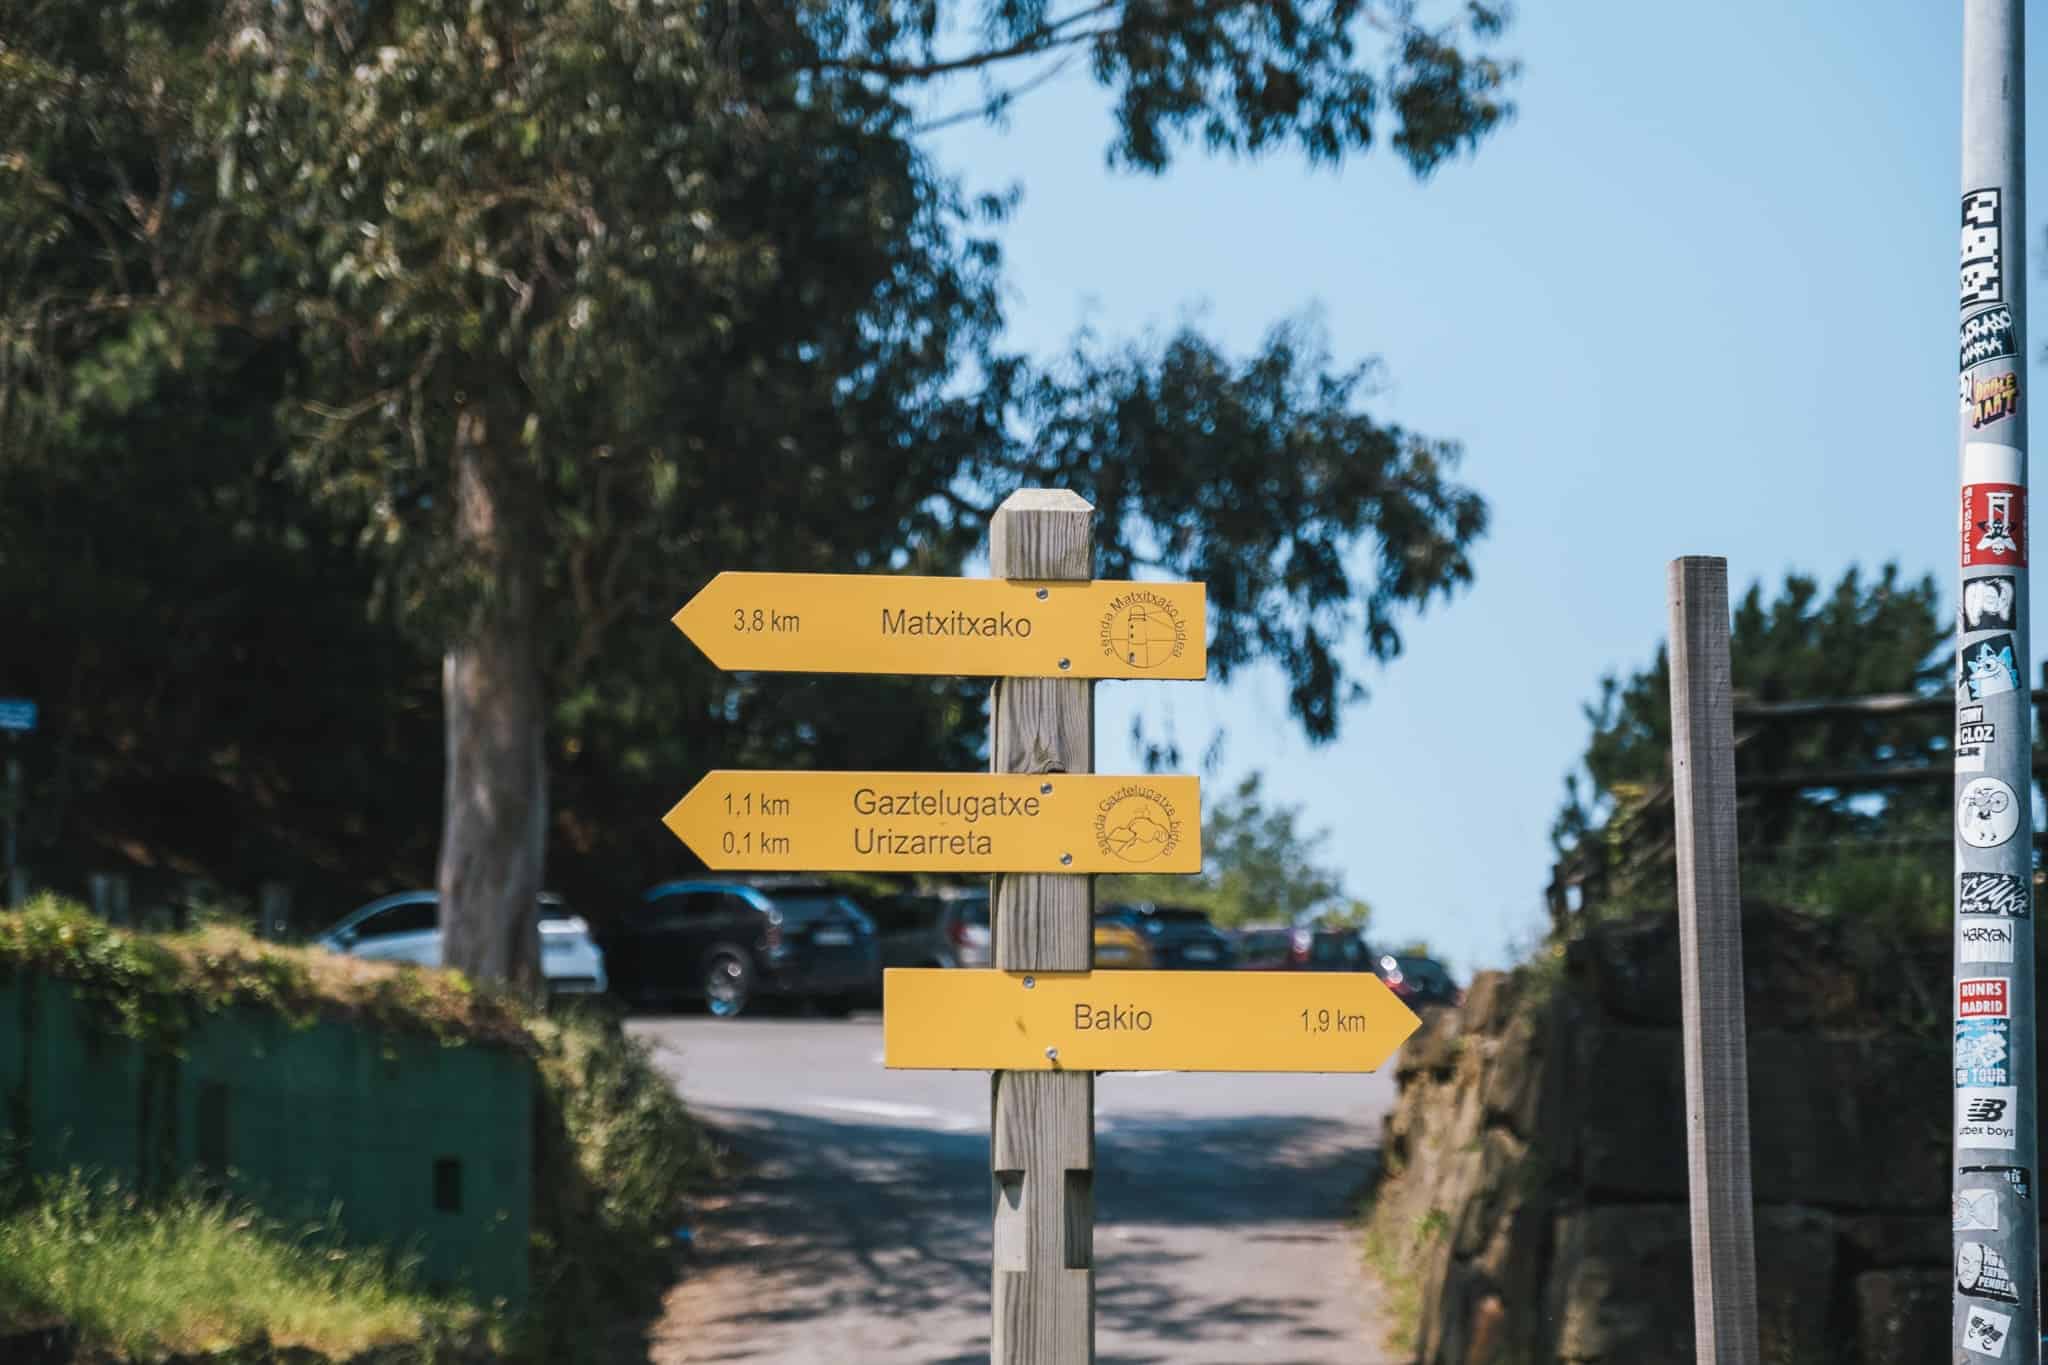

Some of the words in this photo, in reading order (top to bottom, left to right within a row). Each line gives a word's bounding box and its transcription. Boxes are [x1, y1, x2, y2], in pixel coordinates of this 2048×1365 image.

[771, 609, 800, 632] km
[881, 608, 1032, 638] Matxitxako
[761, 793, 789, 816] km
[854, 788, 1040, 823] Gaztelugatxe
[761, 832, 789, 855] km
[854, 827, 993, 856] Urizarreta
[1074, 1003, 1153, 1032] Bakio
[1337, 1009, 1365, 1032] km
